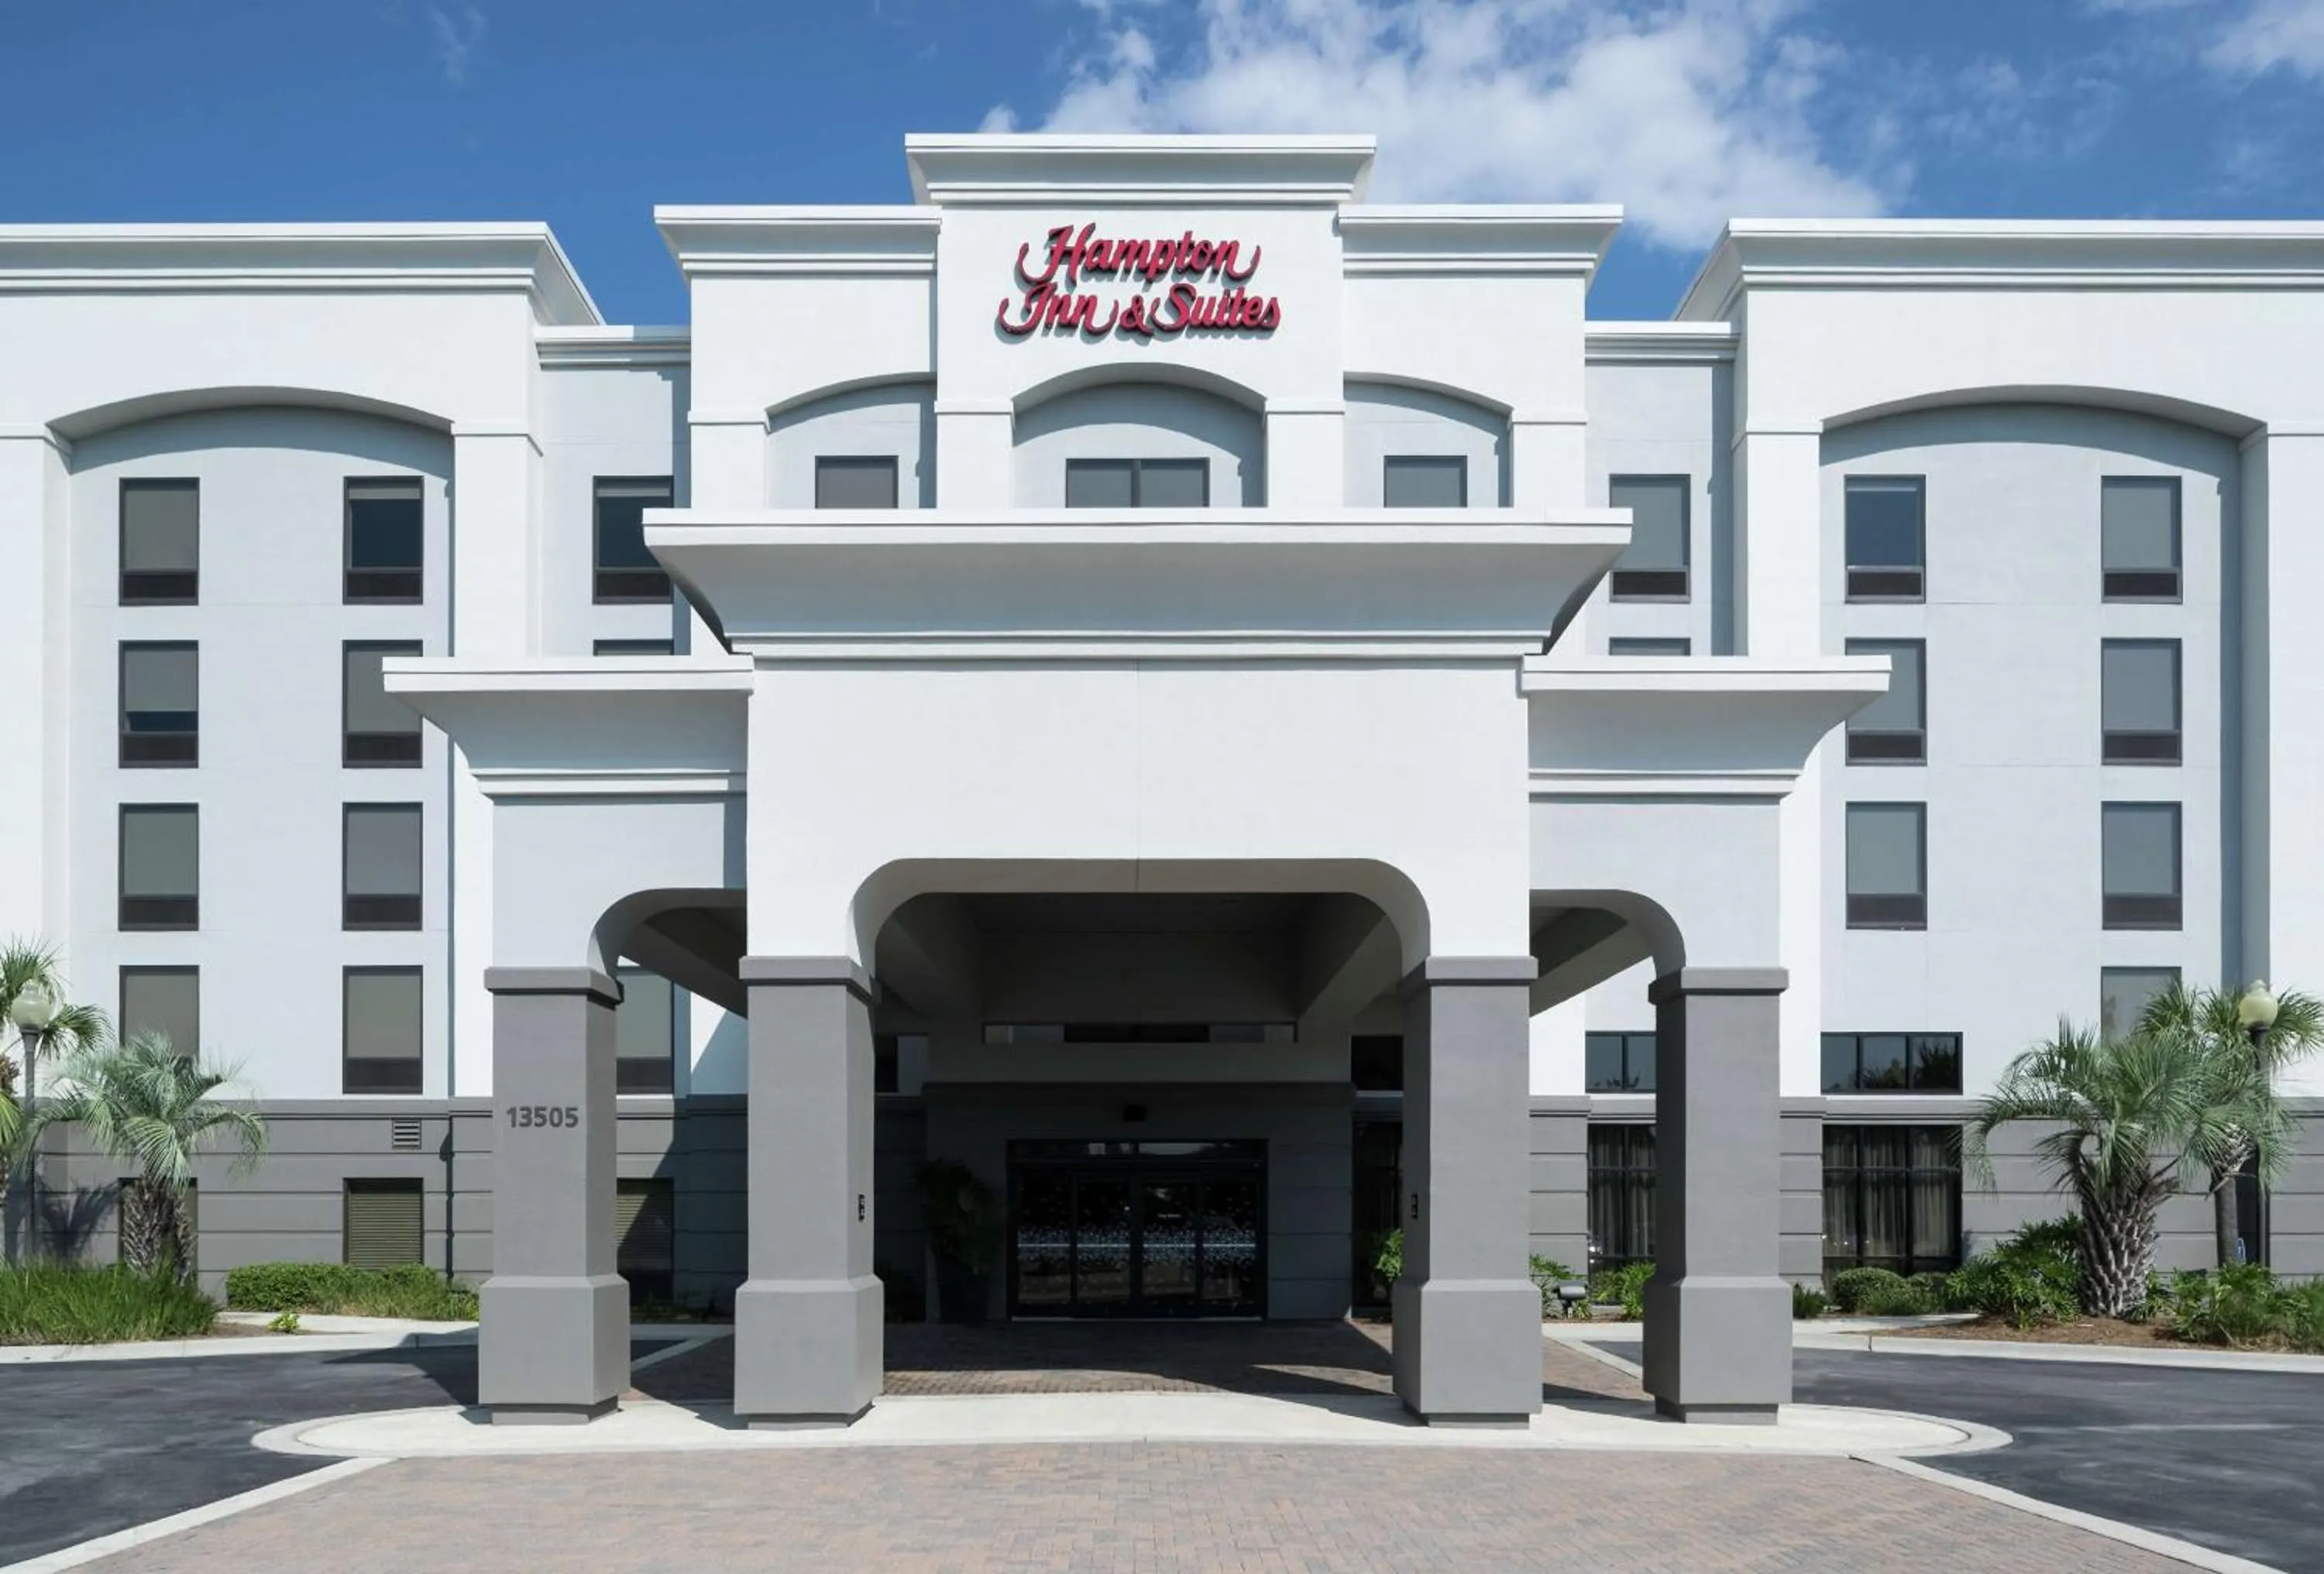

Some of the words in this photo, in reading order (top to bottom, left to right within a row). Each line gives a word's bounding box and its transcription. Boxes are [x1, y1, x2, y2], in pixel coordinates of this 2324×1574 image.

[1018, 222, 1261, 285] Hampton
[998, 282, 1119, 335] Inn
[1119, 294, 1153, 337] &
[1150, 282, 1281, 333] Suites
[506, 1105, 579, 1129] 13505
